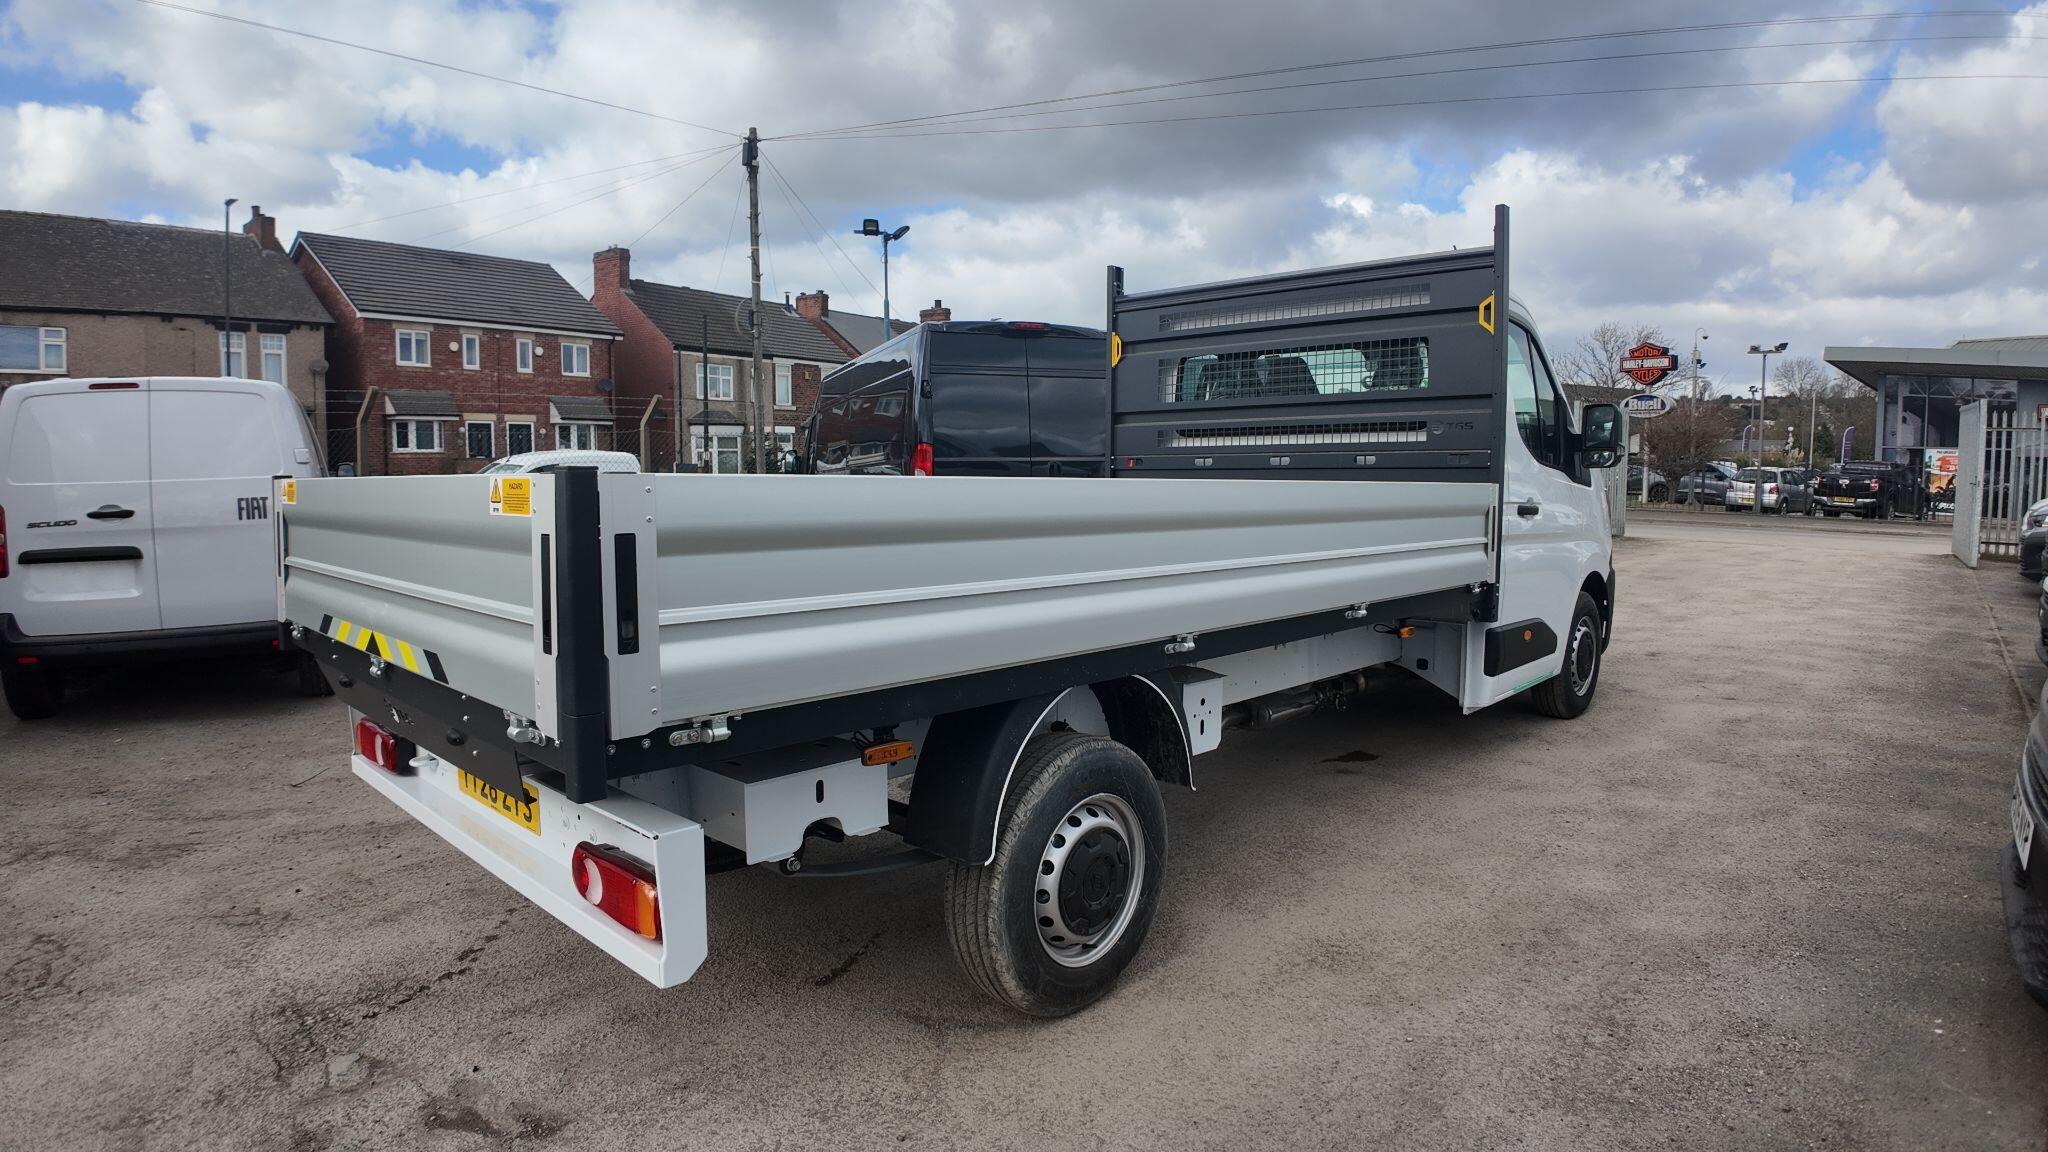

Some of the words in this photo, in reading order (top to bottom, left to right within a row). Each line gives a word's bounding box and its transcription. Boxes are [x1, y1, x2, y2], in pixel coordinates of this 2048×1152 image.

[1633, 346, 1659, 357] MOTOR
[1622, 358, 1669, 369] HARLEY-DAVIDSON
[1633, 370, 1658, 381] CYCLES
[1629, 398, 1661, 410] Buell
[237, 496, 269, 521] FIAT
[26, 519, 78, 529] SCUDO
